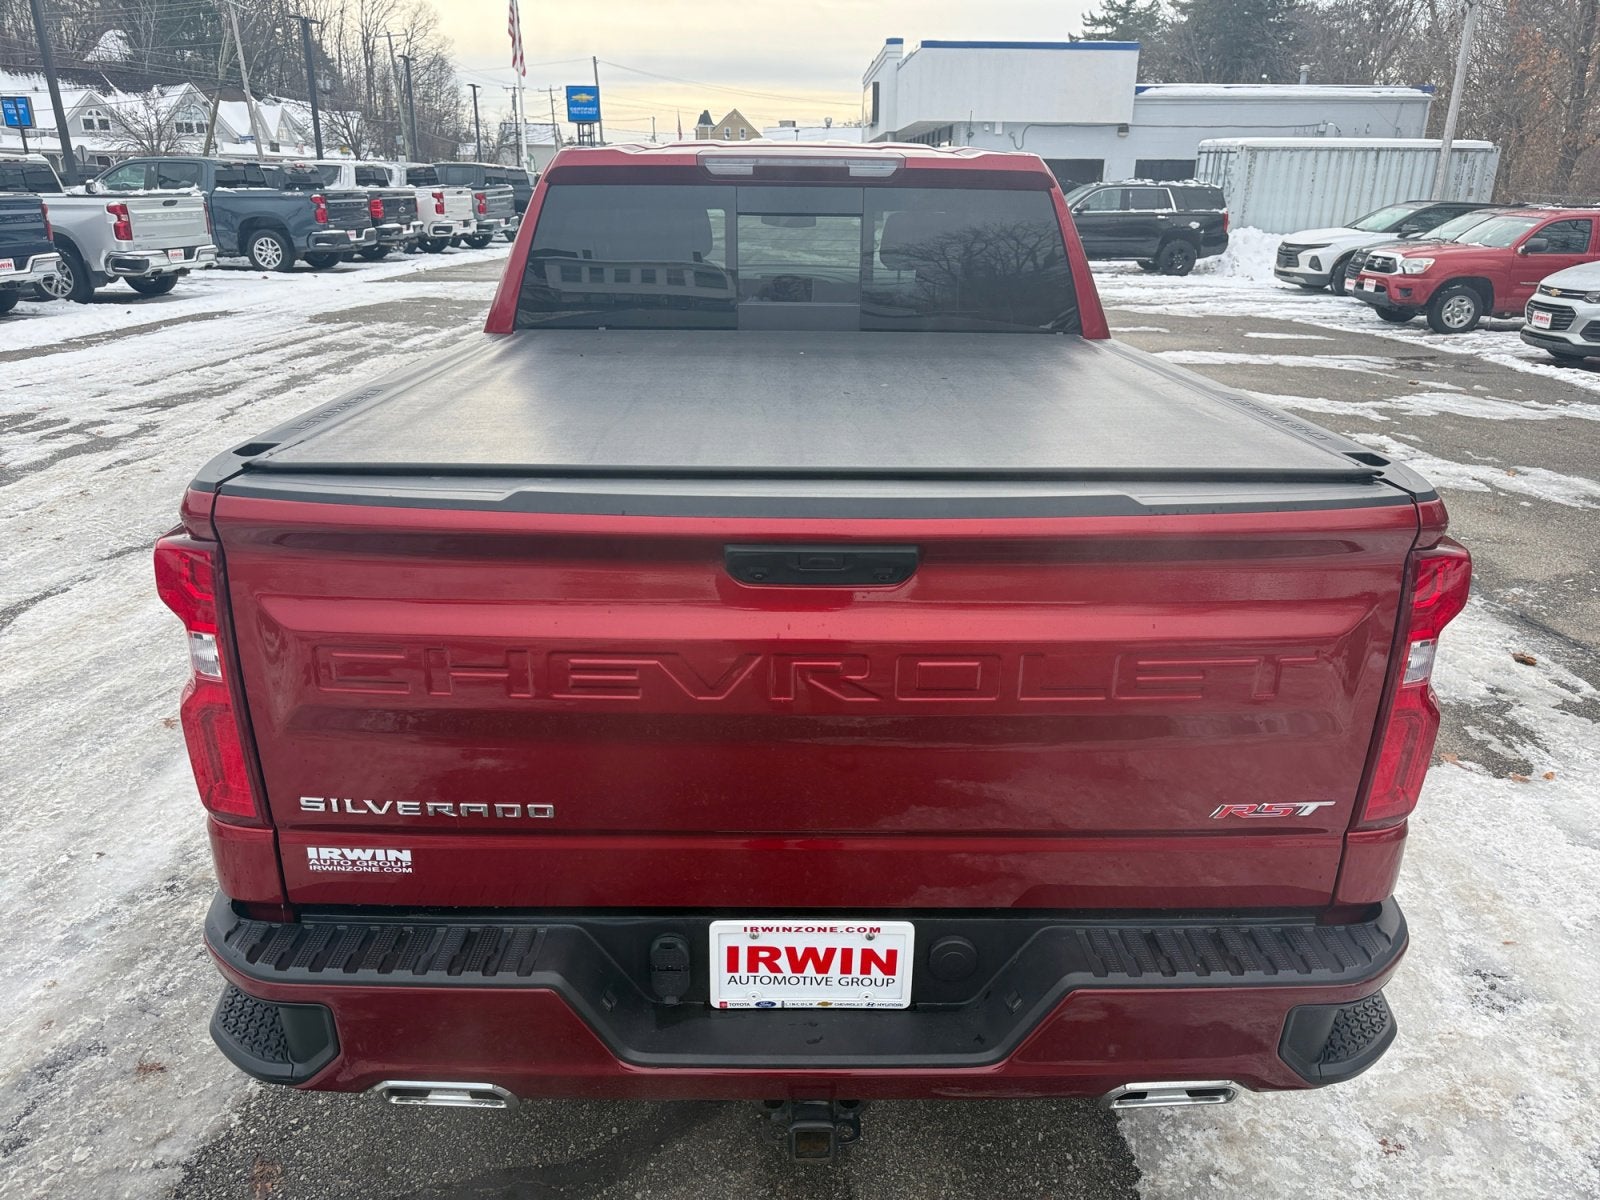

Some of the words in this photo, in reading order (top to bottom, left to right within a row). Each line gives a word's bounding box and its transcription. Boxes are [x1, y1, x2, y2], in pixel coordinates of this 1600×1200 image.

[0, 261, 12, 269] WIN
[312, 645, 1319, 703] CHEVROLET
[299, 796, 555, 819] SILVERADO
[1209, 801, 1336, 819] RST
[306, 847, 412, 861] IRWIN
[309, 865, 413, 874] IRWINZONE.COM
[356, 860, 412, 868] GROUP
[743, 926, 881, 934] IRWINZONE.COM
[726, 945, 898, 976] IRWIN
[727, 975, 833, 988] AUTOMOTIVE
[838, 976, 896, 988] GROUP
